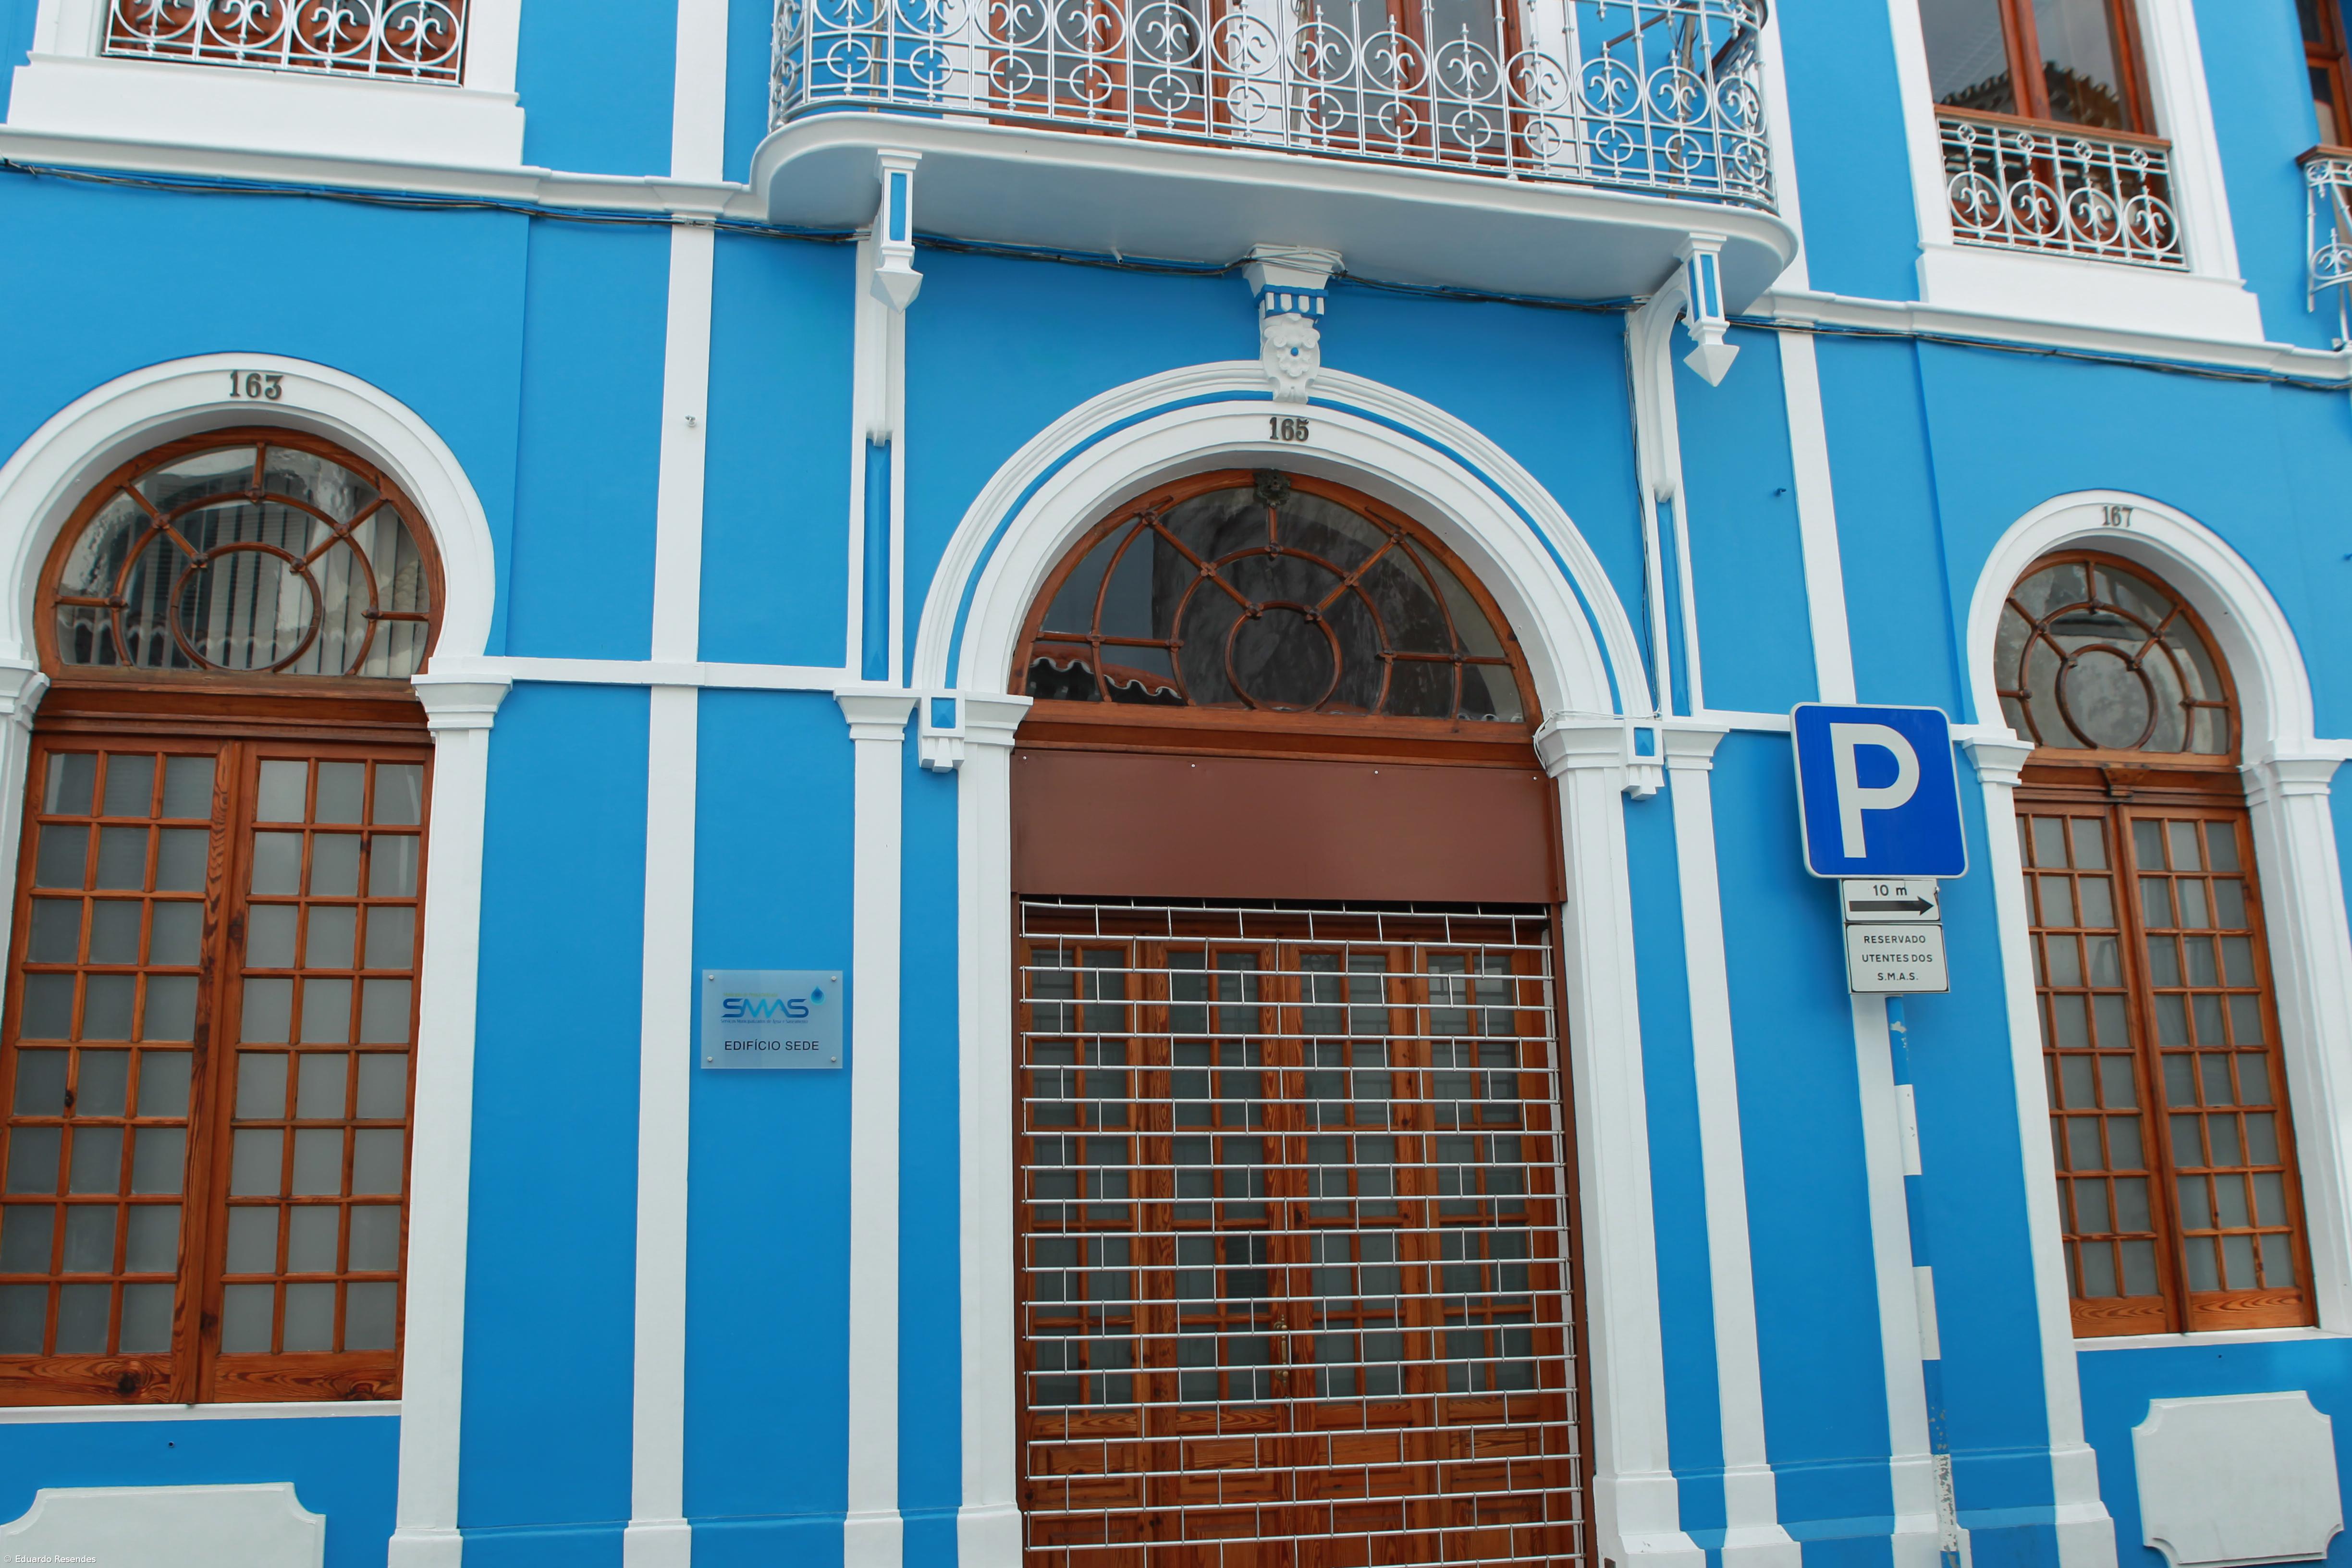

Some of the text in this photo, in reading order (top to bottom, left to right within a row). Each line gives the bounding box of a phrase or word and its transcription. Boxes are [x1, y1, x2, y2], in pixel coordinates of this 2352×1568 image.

[230, 370, 283, 399] 163
[1270, 417, 1309, 441] 165
[2102, 505, 2133, 527] 167
[1829, 723, 1920, 858] P
[1873, 884, 1907, 896] 10 m
[1864, 935, 1926, 943] RESERVADO
[1862, 954, 1909, 962] UTENTES
[1877, 972, 1919, 980] S.M.A.S.
[724, 1039, 819, 1051] EDIFÍCIO SEDE
